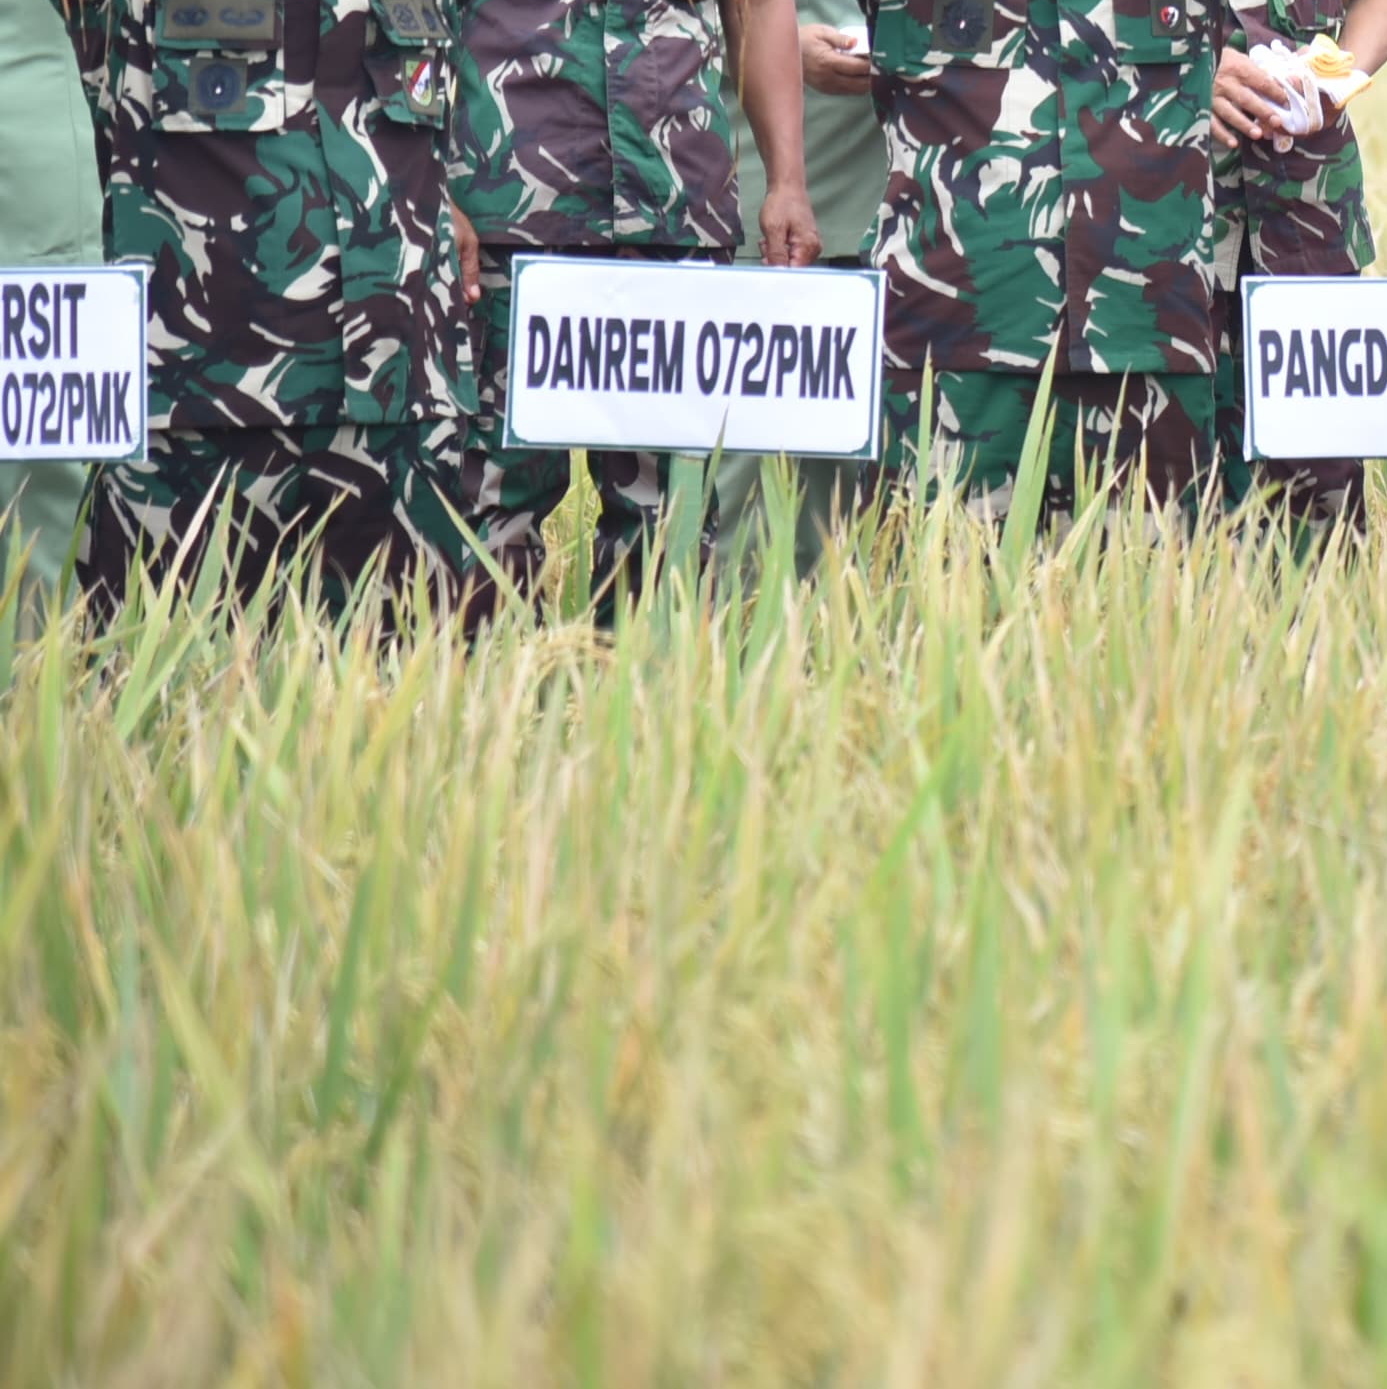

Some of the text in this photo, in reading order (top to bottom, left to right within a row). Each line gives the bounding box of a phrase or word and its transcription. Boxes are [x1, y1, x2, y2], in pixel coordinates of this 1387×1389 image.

[1, 282, 87, 360] RSIT
[526, 314, 858, 400] DANREM 072/PMK
[1, 371, 132, 446] 072/PMK
